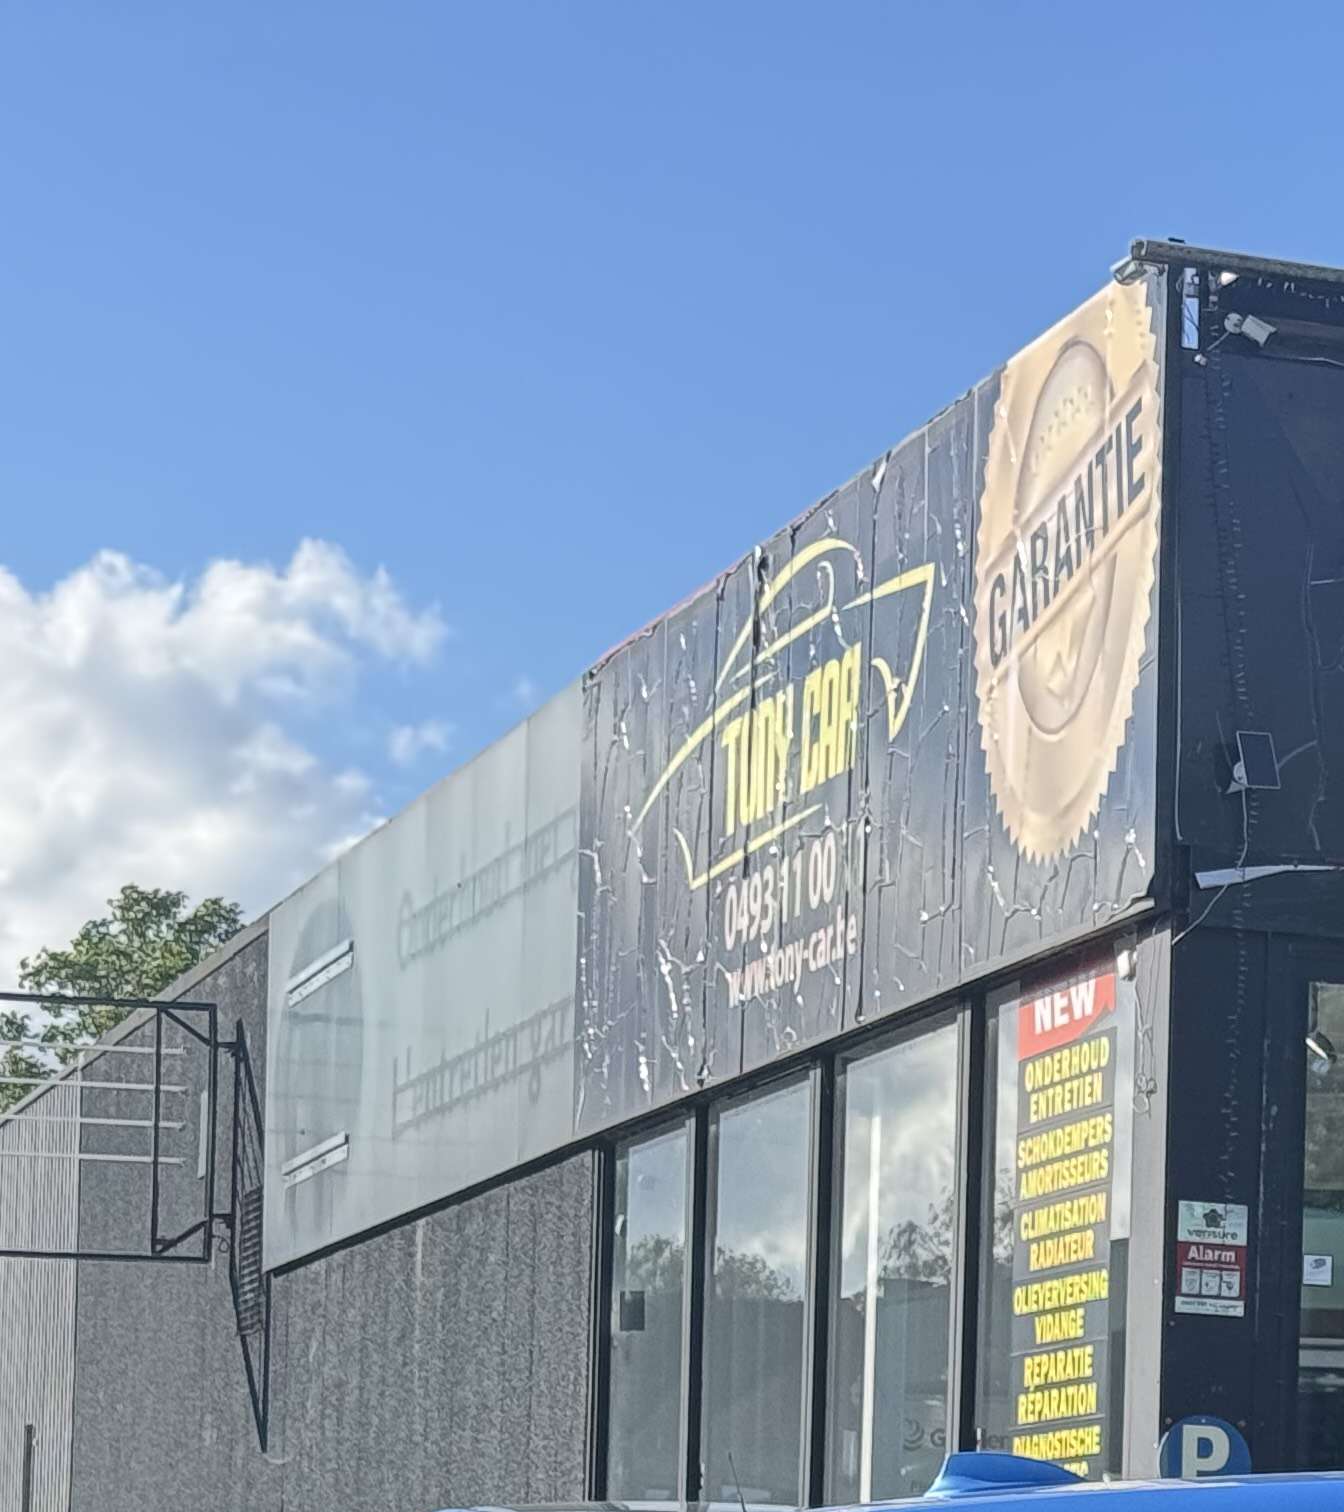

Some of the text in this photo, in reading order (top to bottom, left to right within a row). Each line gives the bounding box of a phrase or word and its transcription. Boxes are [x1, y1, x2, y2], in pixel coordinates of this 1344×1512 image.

[988, 400, 1148, 667] GARANTIE
[725, 866, 774, 950] 0493
[808, 831, 836, 909] 00
[1033, 978, 1096, 1035] NEW
[1024, 1036, 1110, 1092] ONDERHOUD
[1029, 1072, 1103, 1124] ENTRETIEN
[1017, 1113, 1113, 1169] SCHOKDEMPERS
[1020, 1149, 1109, 1200] AMORTISSEURS
[1020, 1192, 1107, 1241] CLIMATISATION
[1029, 1229, 1096, 1272] RADIATEUR
[1187, 1245, 1237, 1263] Alarm
[1013, 1268, 1109, 1316] OLIEVERVERSING
[1034, 1308, 1086, 1344] VIDANGE
[1023, 1345, 1095, 1387] REPARATIE
[1012, 1425, 1102, 1460] DIAGNOSTISCHE
[1181, 1423, 1231, 1481] P
